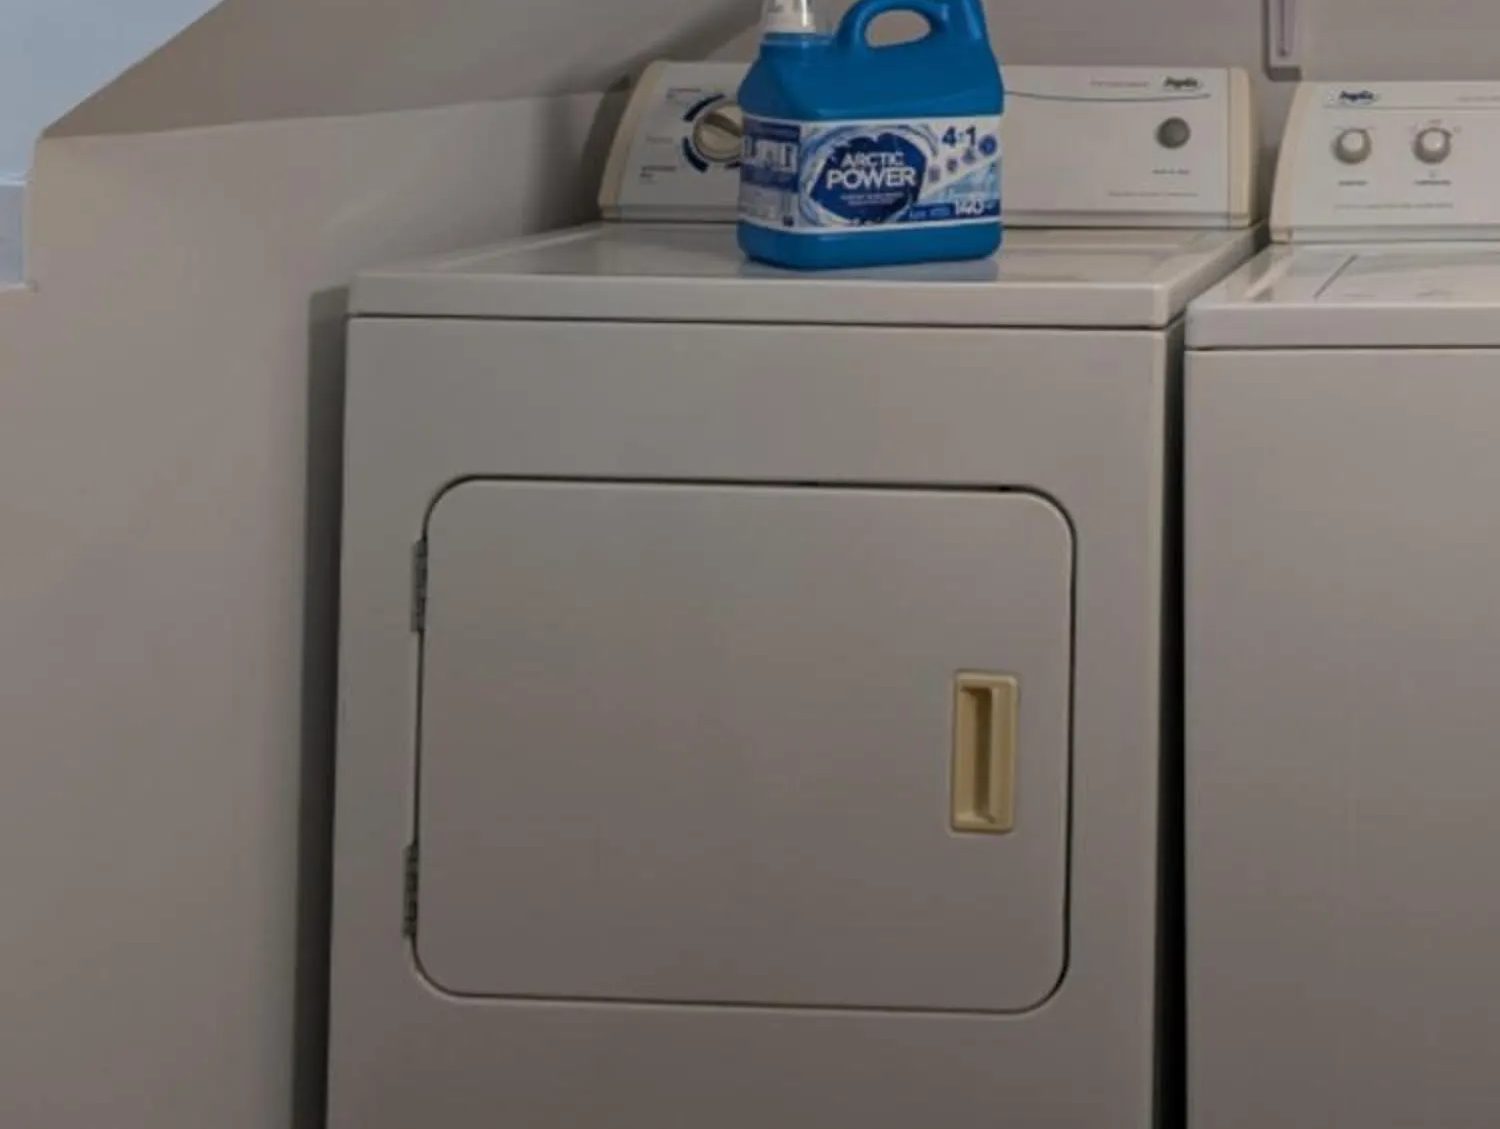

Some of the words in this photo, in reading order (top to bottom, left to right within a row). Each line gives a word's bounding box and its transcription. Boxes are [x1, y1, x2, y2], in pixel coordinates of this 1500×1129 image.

[942, 126, 957, 147] 4
[966, 125, 976, 147] 1
[840, 151, 904, 167] ARCTIC
[826, 167, 916, 190] POWER
